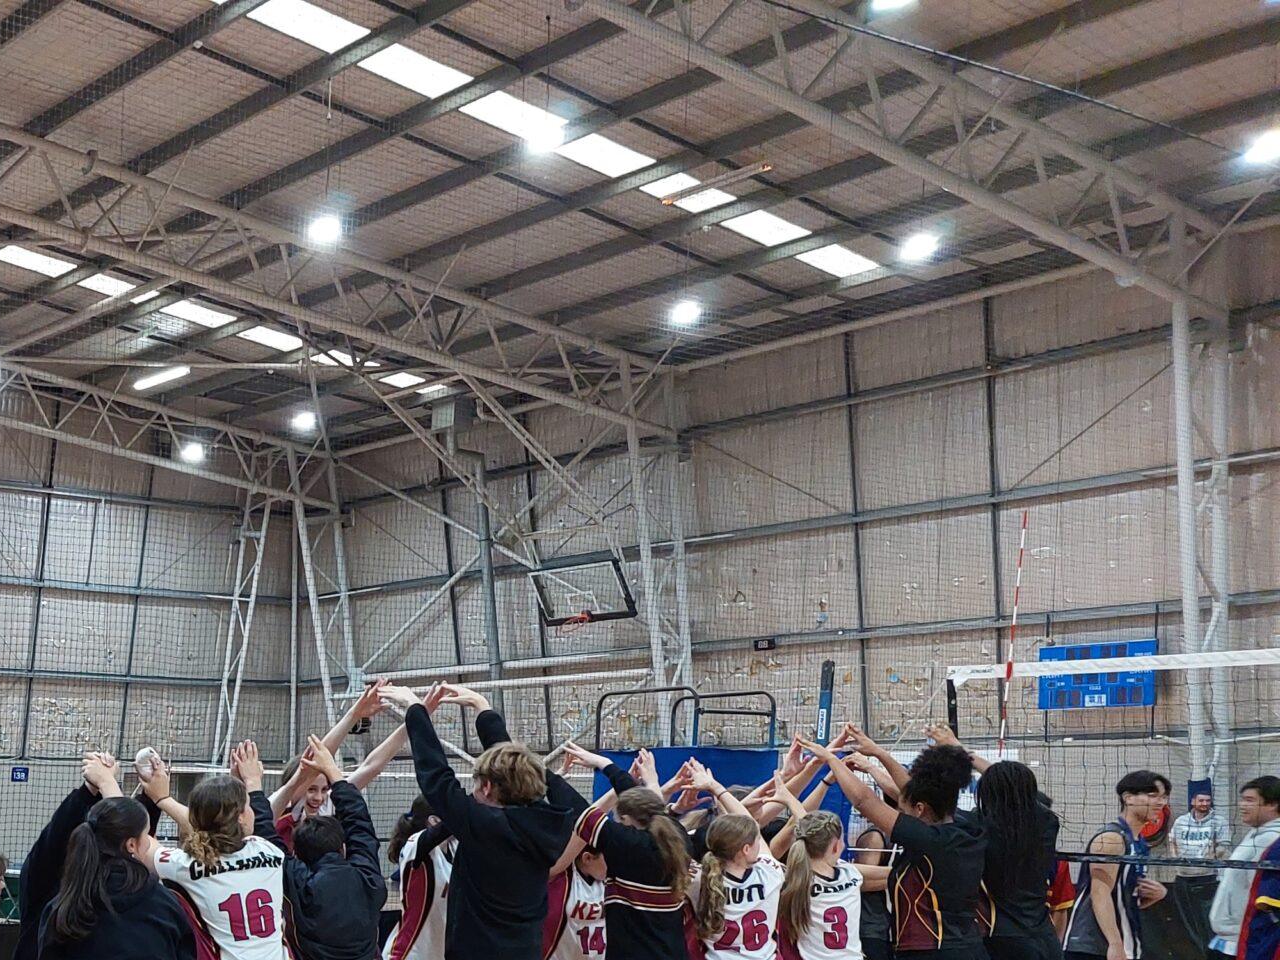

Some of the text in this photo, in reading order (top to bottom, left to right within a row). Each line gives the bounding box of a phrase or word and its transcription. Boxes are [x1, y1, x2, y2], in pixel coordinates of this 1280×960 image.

[218, 888, 277, 942] 16
[570, 899, 606, 920] KE
[713, 909, 769, 952] 26
[823, 906, 849, 950] 3
[576, 926, 606, 955] 14
